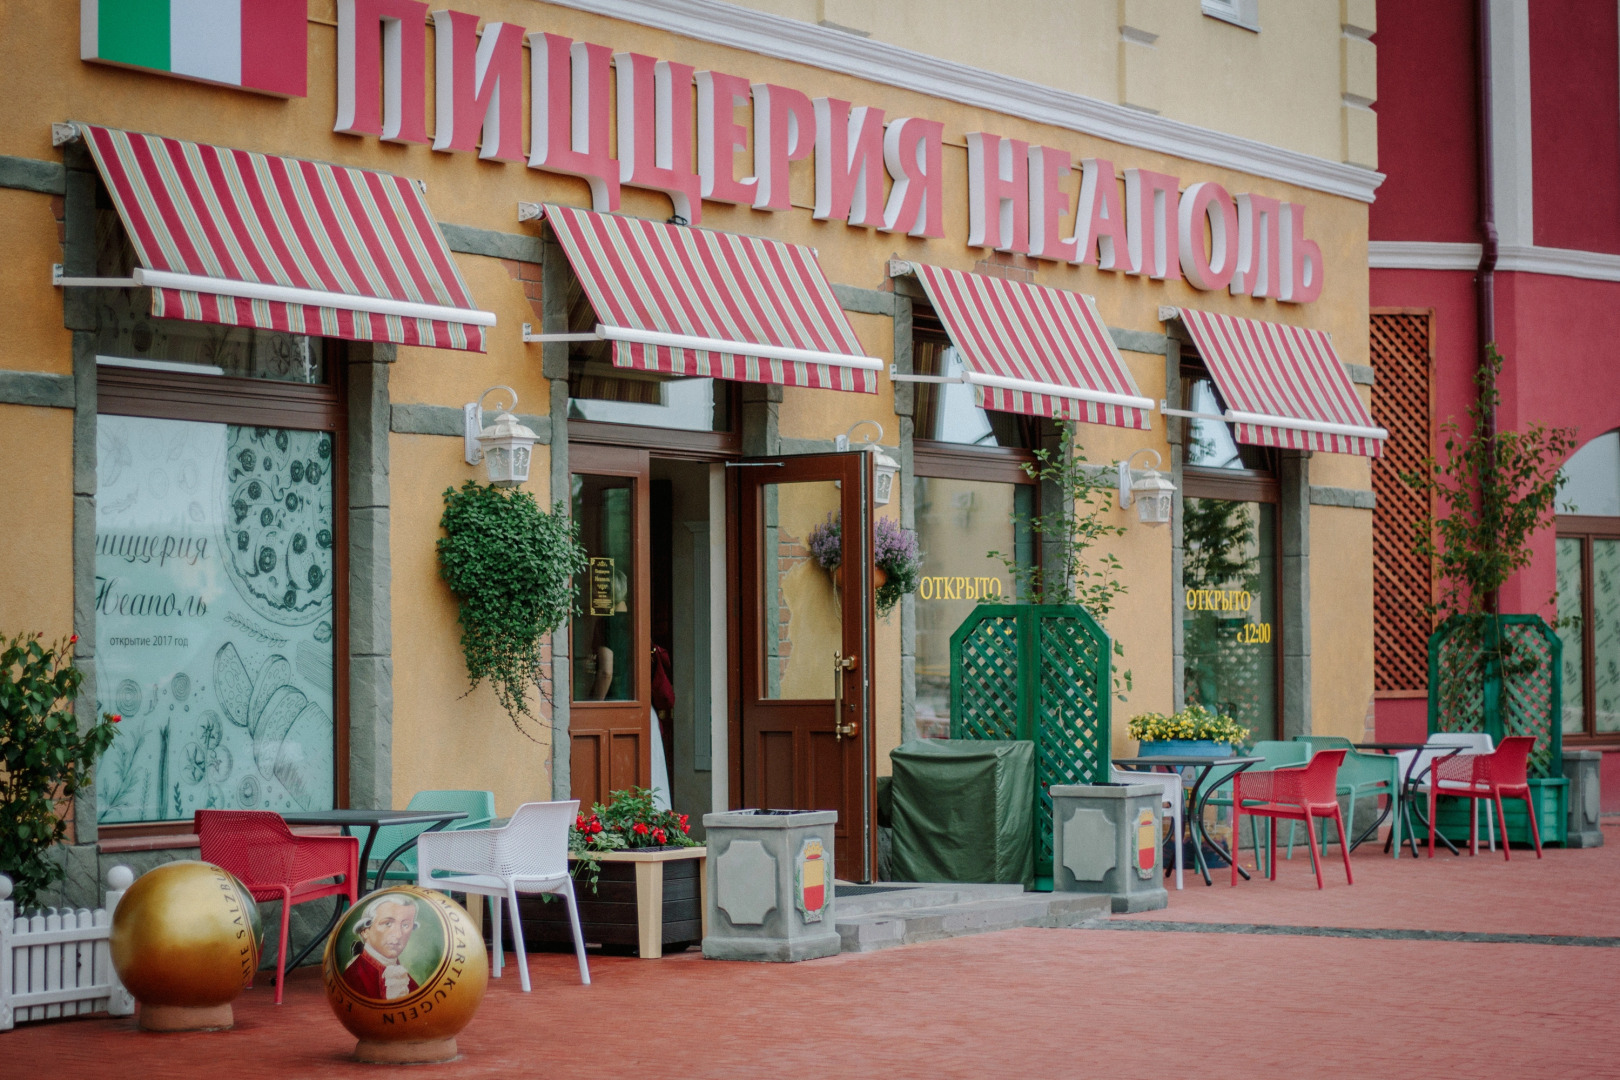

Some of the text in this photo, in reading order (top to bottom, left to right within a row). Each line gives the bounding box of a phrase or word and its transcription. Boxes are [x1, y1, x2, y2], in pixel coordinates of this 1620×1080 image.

[333, 0, 1323, 304] ПИЦЦЕРИЯ НЕАПОЛЬ
[96, 576, 207, 617] Неаполь
[920, 576, 1002, 600] ОТКРЫТО
[1186, 589, 1251, 611] ОТКРЫТО
[110, 635, 189, 648] открытие 2017 год
[1243, 622, 1271, 643] 12:00
[383, 899, 467, 1025] MOZARTKUGELN
